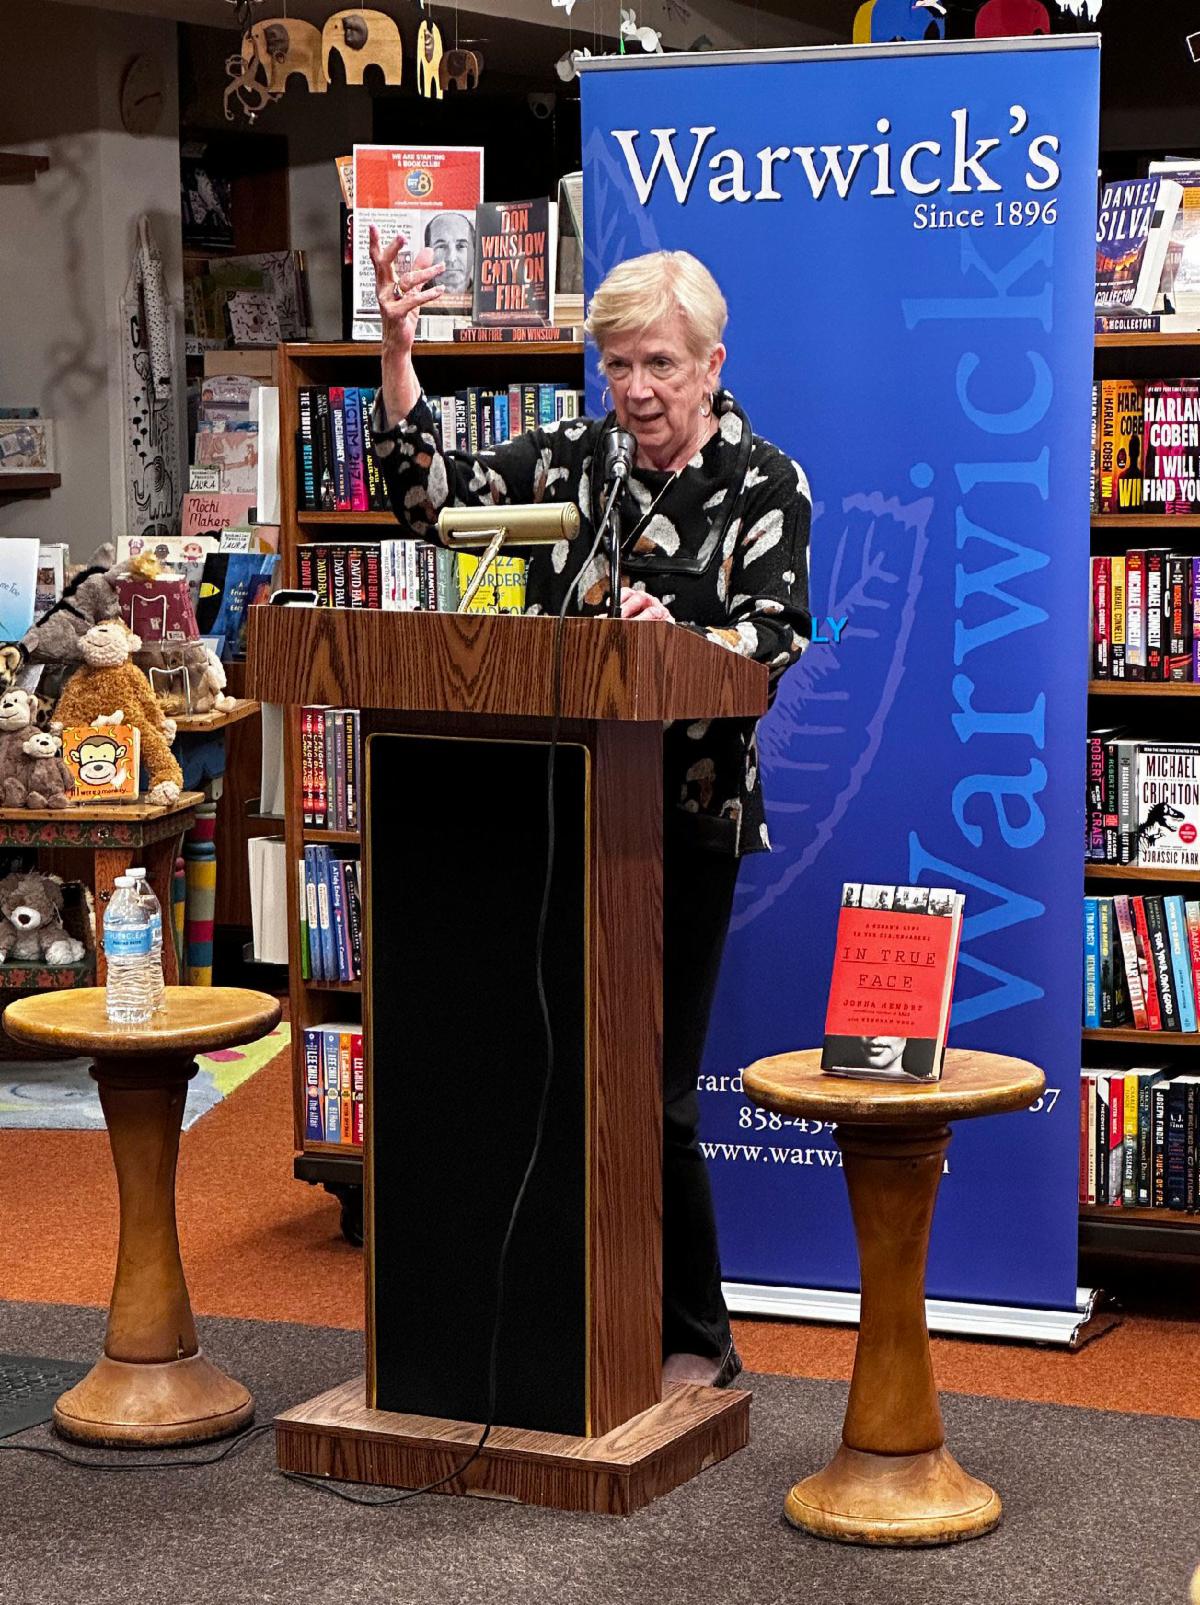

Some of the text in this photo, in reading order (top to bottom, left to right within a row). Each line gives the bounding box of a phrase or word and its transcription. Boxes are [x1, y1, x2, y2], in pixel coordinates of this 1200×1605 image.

[610, 105, 1061, 206] Warwick's
[1102, 182, 1157, 209] DANIEL
[501, 209, 528, 233] DON
[913, 199, 1058, 229] Since 1896
[1096, 207, 1151, 242] SILVA
[482, 232, 545, 257] WINSLOW
[481, 257, 544, 284] CITY ON
[496, 284, 529, 309] FIRE
[460, 329, 560, 341] CITY ON FIRE DON WINSLOW
[456, 399, 466, 434] ARCHER
[525, 393, 534, 413] KATE
[1144, 398, 1200, 421] HARLAN
[345, 390, 359, 447] VICTIM
[334, 409, 345, 462] UNDERMONEY
[1102, 398, 1113, 497] HARLAN COBEN WIN
[1150, 424, 1198, 447] COBEN
[1155, 456, 1195, 477] I WILL
[1143, 479, 1200, 501] FIND YOU
[189, 498, 219, 512] Mochi
[190, 513, 230, 526] Makers
[301, 561, 311, 585] DAVID
[317, 558, 326, 582] DAVID
[334, 559, 344, 587] DAVID
[351, 559, 361, 587] DAVID
[367, 558, 378, 584] DAVID
[428, 573, 436, 610] BANVILLE
[1128, 571, 1141, 607] MICHAEL
[1149, 572, 1160, 607] MICHAEL
[1173, 585, 1182, 634] MICHAEL CONNELLY
[811, 616, 848, 644] LY
[1114, 613, 1122, 641] CONNELLY
[1128, 608, 1141, 647] CONNELLY
[1149, 608, 1161, 648] CONNELLY
[1091, 738, 1101, 783] ROBERT
[1146, 755, 1196, 778] MICHAEL
[1143, 782, 1199, 805] CRICHTON
[1092, 812, 1102, 845] CRAIS
[1182, 852, 1199, 864] PARK
[842, 947, 936, 965] IN TRUE
[1190, 927, 1200, 963] DAMAGE
[858, 974, 913, 989] FACE
[1123, 950, 1141, 997] STARTED
[1155, 950, 1167, 974] YOUR
[1162, 993, 1172, 1015] GOOD
[307, 1051, 317, 1064] LEE
[328, 1054, 336, 1066] LEE
[307, 1065, 317, 1085] CHILD
[329, 1067, 337, 1084] CHILD
[354, 1058, 363, 1090] LEE CHILD
[1156, 1092, 1164, 1145] JOSEPH FINDER
